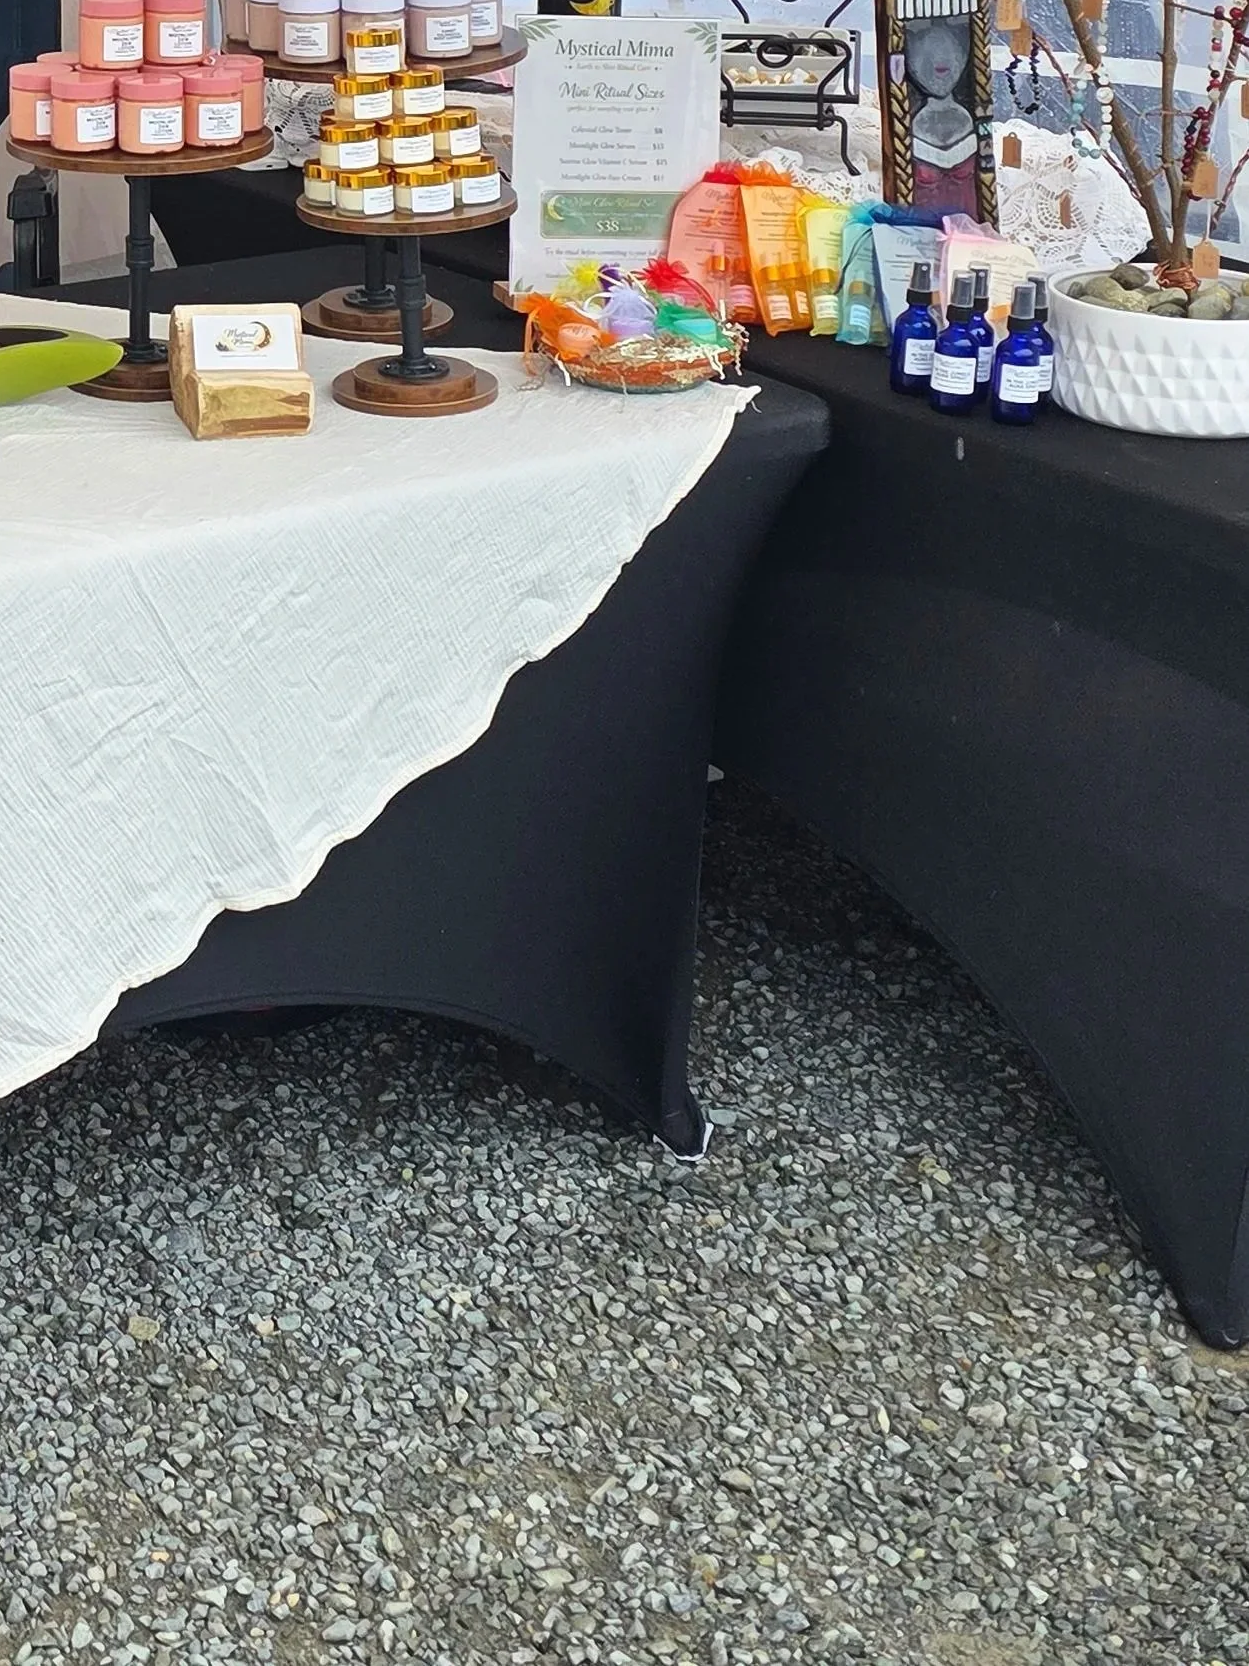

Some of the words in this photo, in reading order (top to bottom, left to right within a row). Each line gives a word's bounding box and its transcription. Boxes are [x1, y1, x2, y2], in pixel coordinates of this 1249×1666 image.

[554, 38, 623, 61] Mystical
[626, 39, 674, 59] Mima
[558, 81, 591, 99] Mini
[593, 81, 634, 101] Ritual
[634, 82, 665, 101] Sizes
